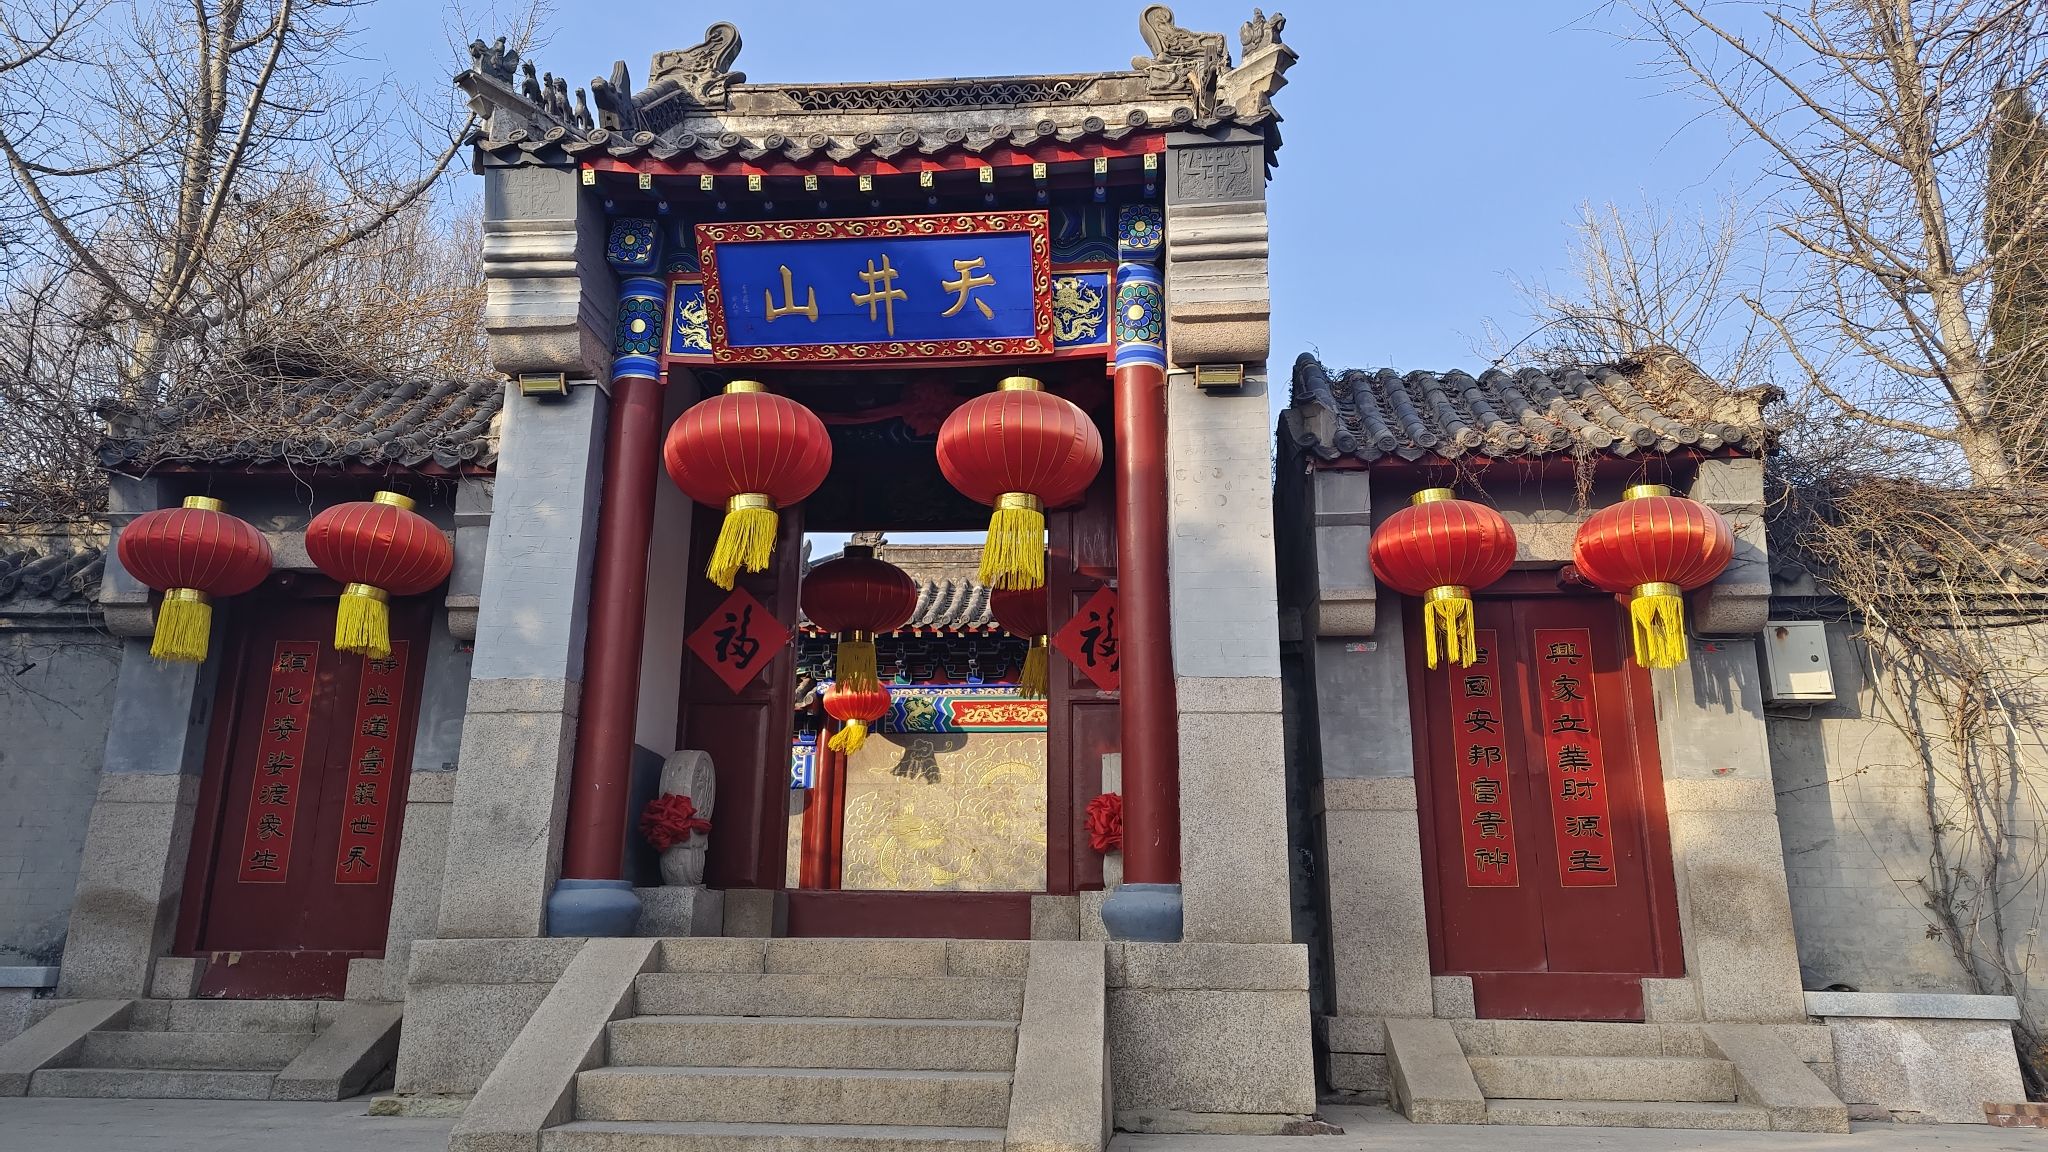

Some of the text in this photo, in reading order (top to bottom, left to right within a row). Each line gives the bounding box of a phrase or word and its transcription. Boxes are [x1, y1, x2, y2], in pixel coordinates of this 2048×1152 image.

[764, 253, 997, 338] 天井山
[713, 603, 760, 670] 福
